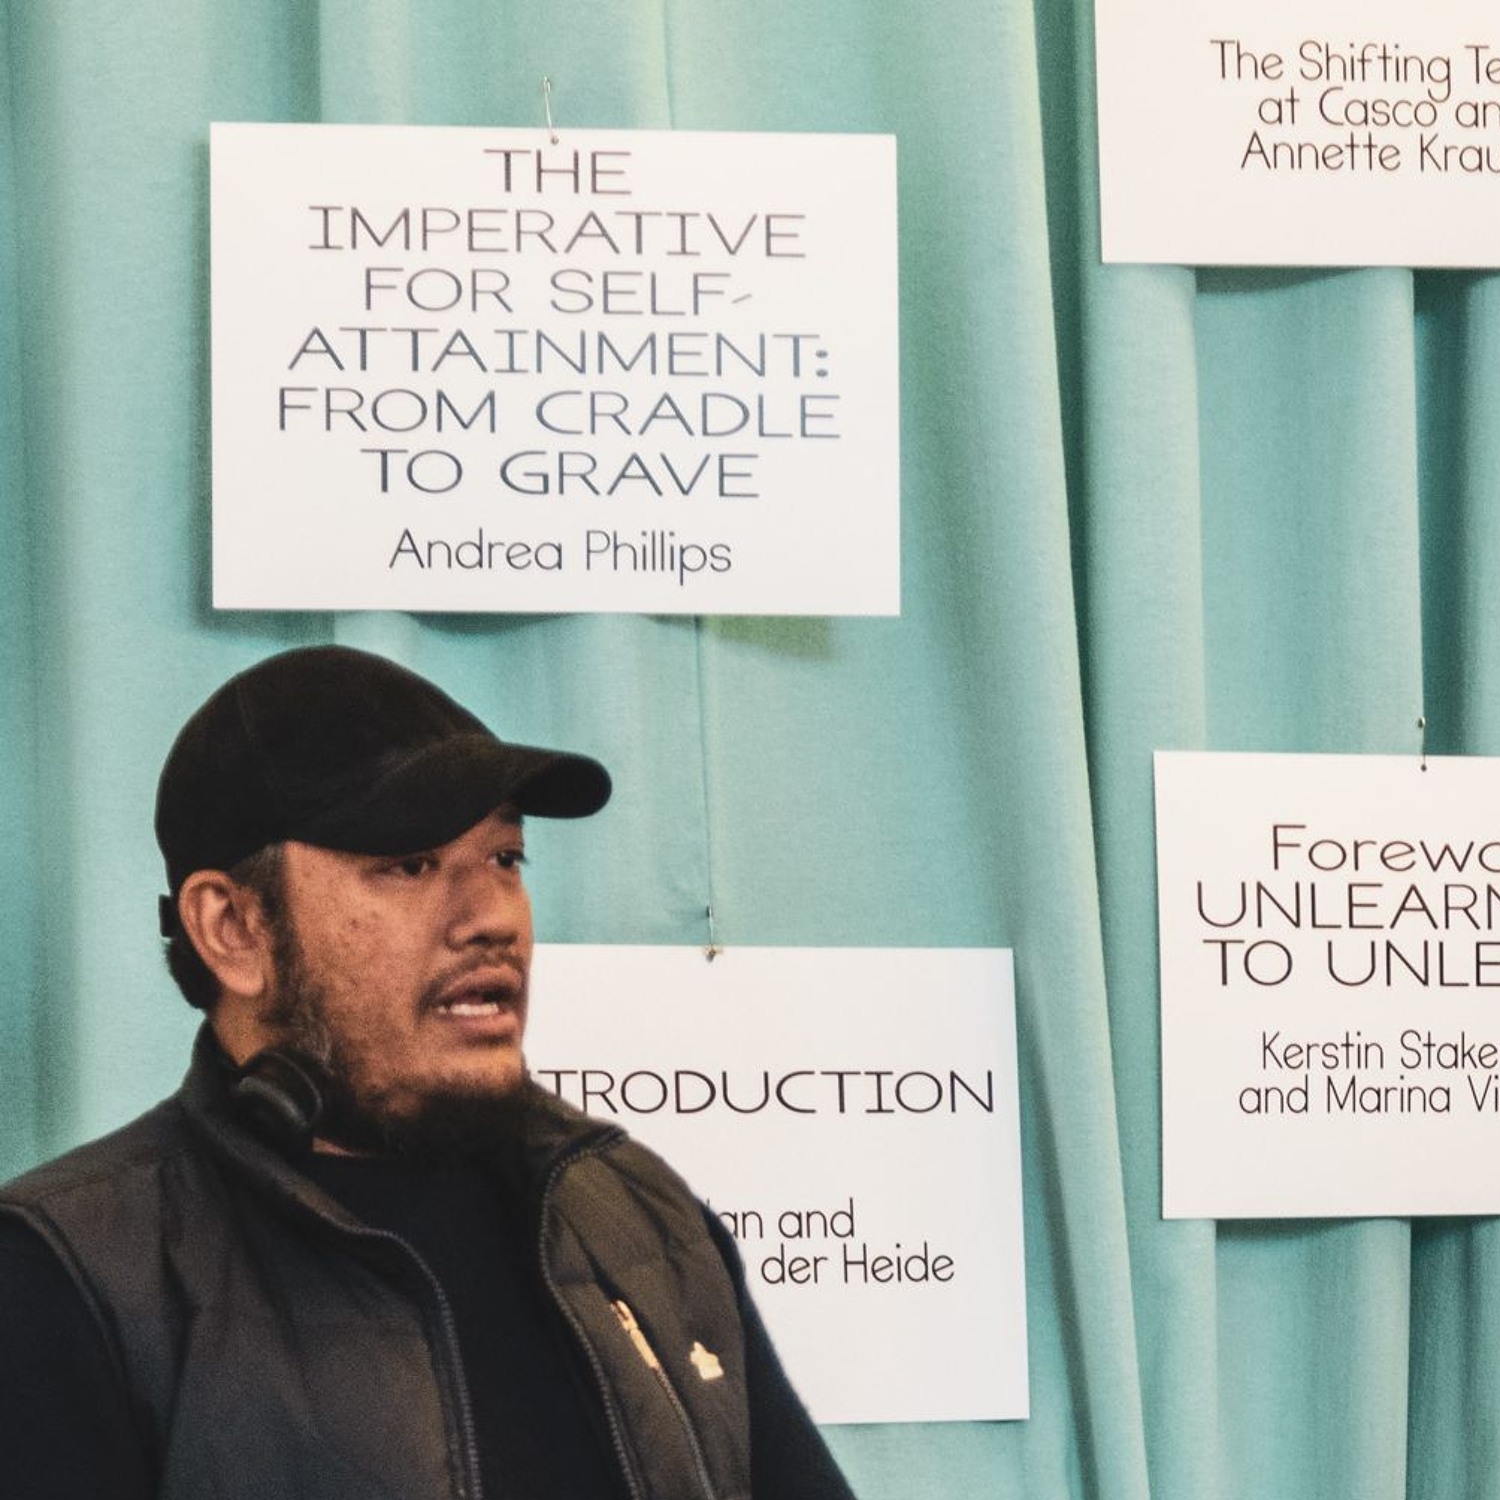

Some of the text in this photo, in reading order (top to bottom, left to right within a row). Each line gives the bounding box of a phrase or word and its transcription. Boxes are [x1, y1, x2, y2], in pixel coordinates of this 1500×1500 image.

[1211, 40, 1283, 80] The
[1299, 41, 1451, 103] Shifting
[1258, 86, 1300, 125] at
[1319, 87, 1437, 127] Casco
[485, 150, 630, 194] THE
[1241, 131, 1400, 171] Annette
[310, 206, 804, 257] IMPERATIVE
[366, 268, 753, 316] FOR SELF-
[288, 327, 827, 377] ATTAINMENT:
[279, 387, 839, 438] FROM CRADLE
[361, 449, 758, 497] TO GRAVE
[389, 528, 731, 586] Andrea Phillips
[1203, 939, 1293, 986] TO
[1262, 1031, 1384, 1070] Kerstin
[538, 1070, 994, 1114] TRODUCTION
[1239, 1074, 1308, 1114] and
[1327, 1075, 1450, 1114] Marina
[707, 1197, 855, 1239] an and
[761, 1241, 954, 1284] der Heide
